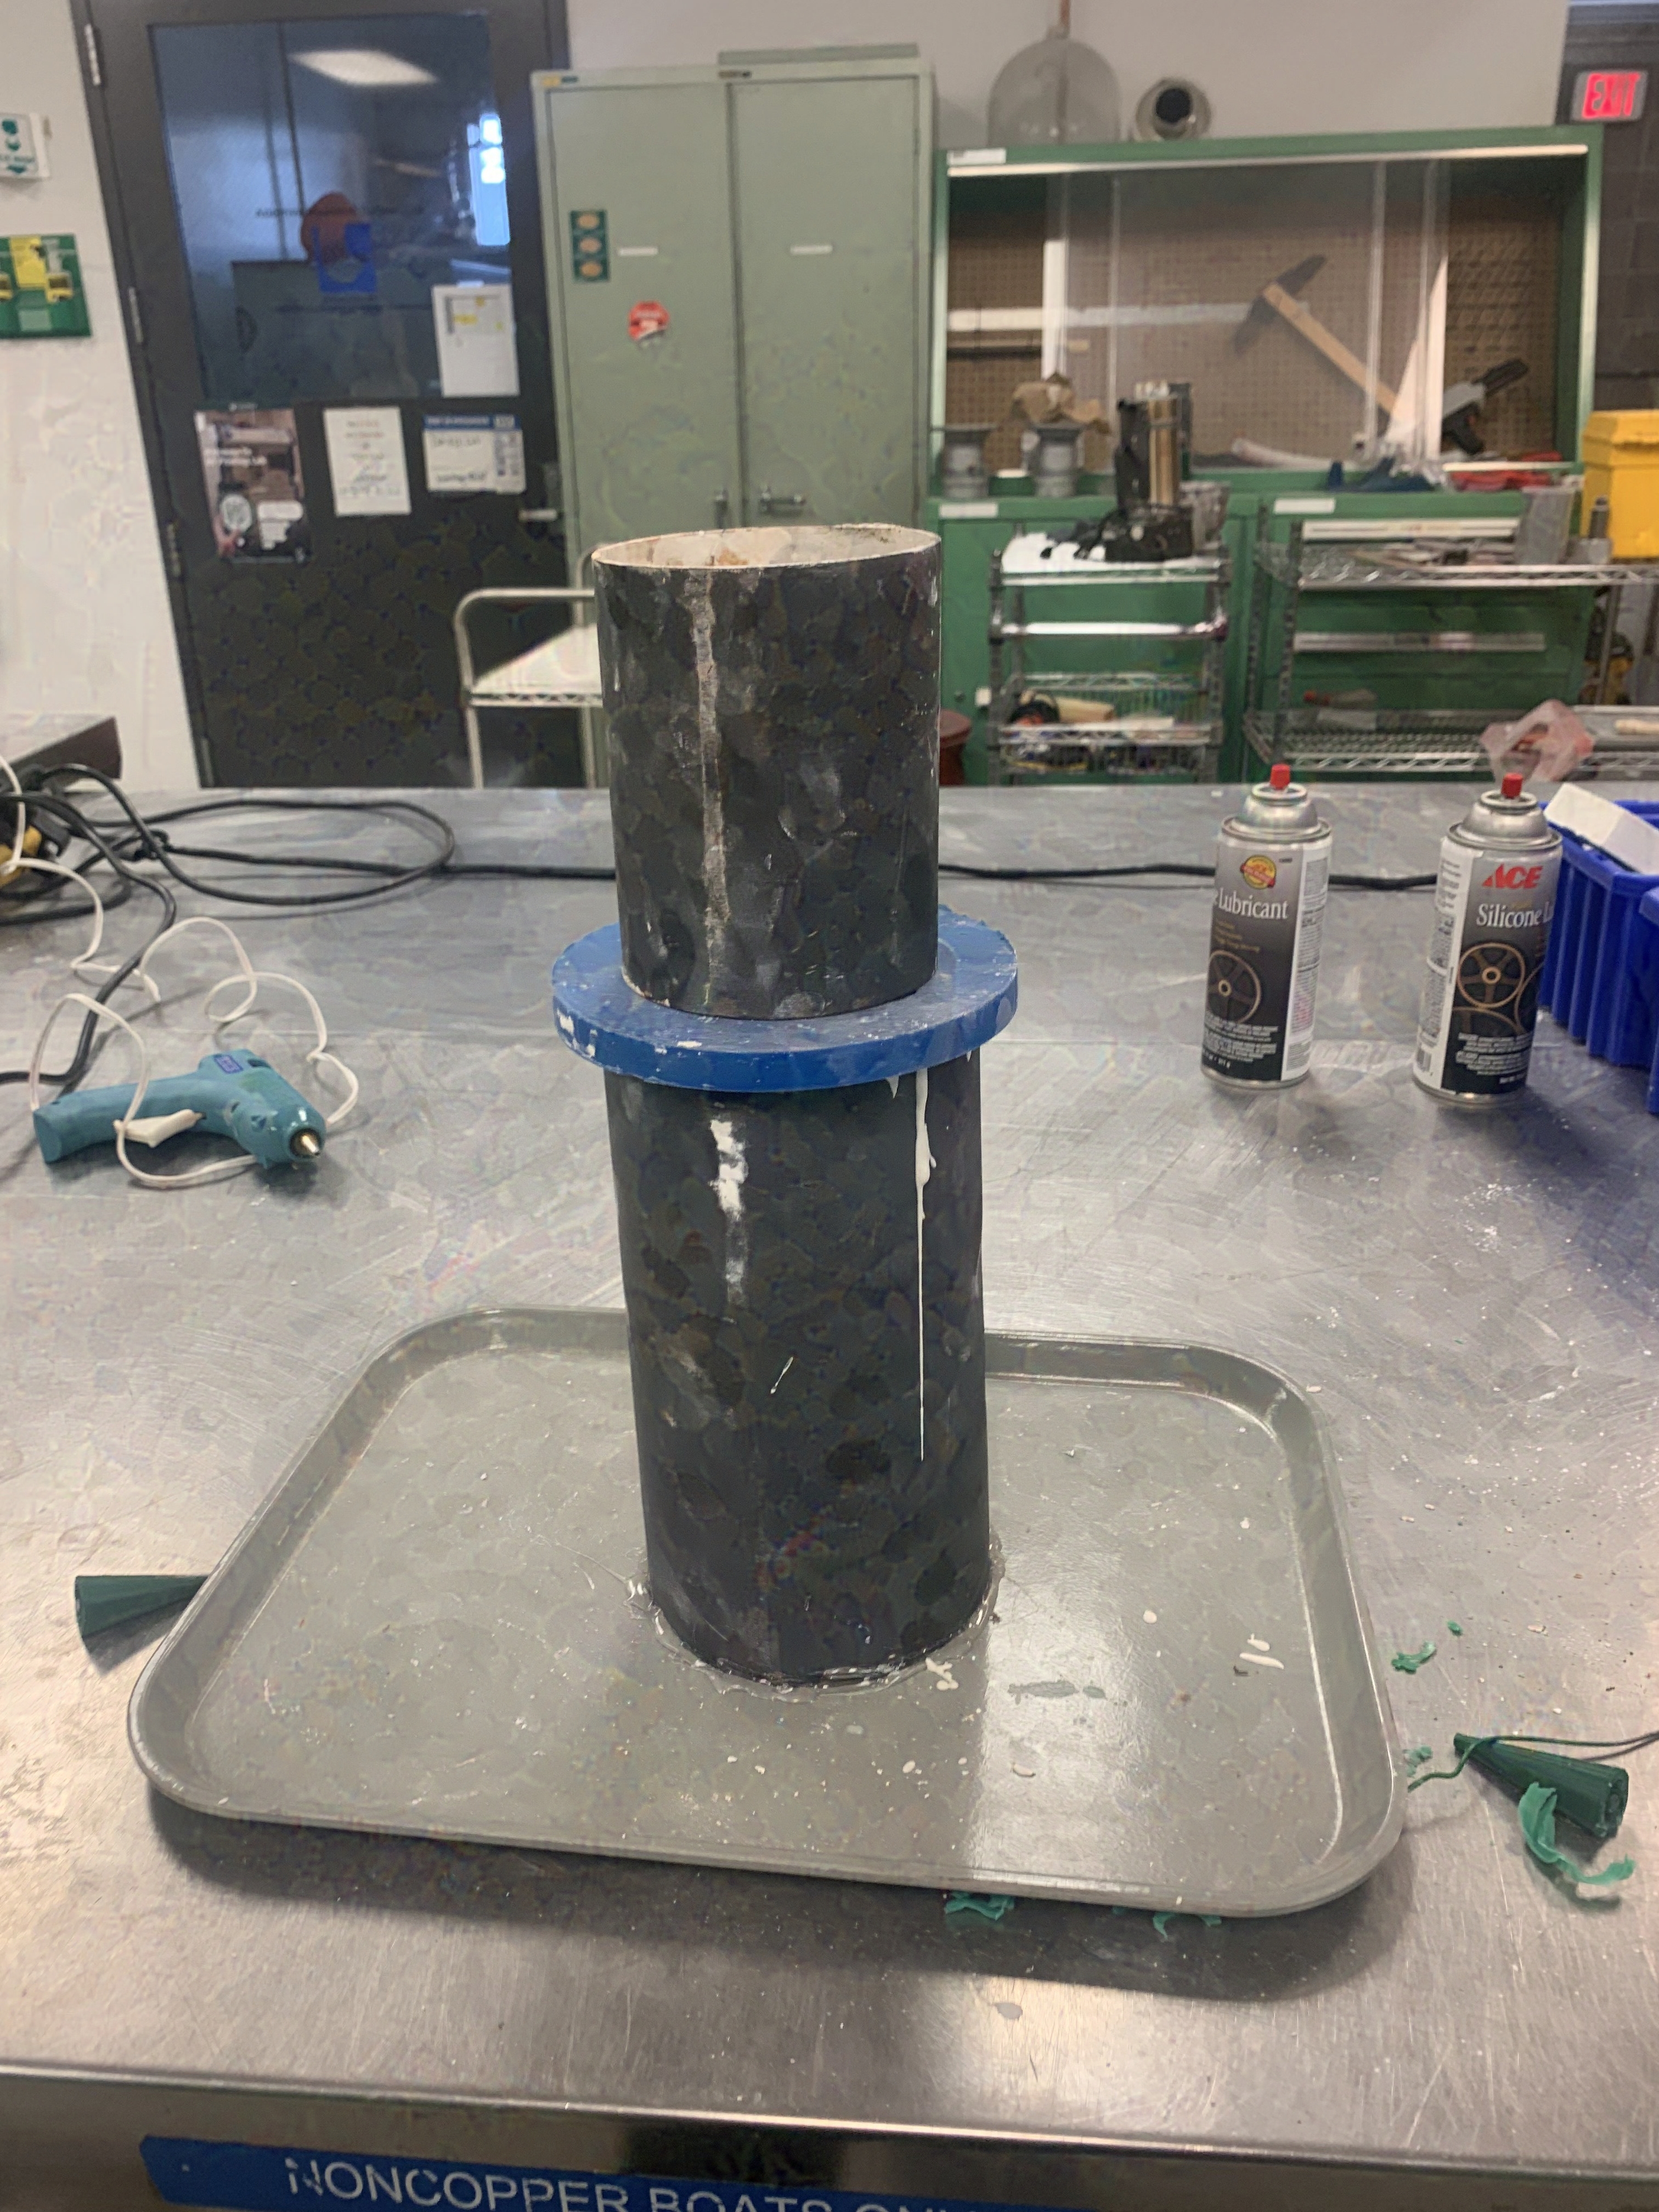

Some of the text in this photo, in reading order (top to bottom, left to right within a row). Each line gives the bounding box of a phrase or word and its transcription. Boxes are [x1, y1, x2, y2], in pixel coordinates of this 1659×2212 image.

[1582, 71, 1640, 119] EXIT
[1482, 863, 1543, 889] ACE
[1218, 887, 1288, 919] Lubricant
[1476, 903, 1542, 928] Silicone
[284, 2157, 629, 2212] NONCOPPER
